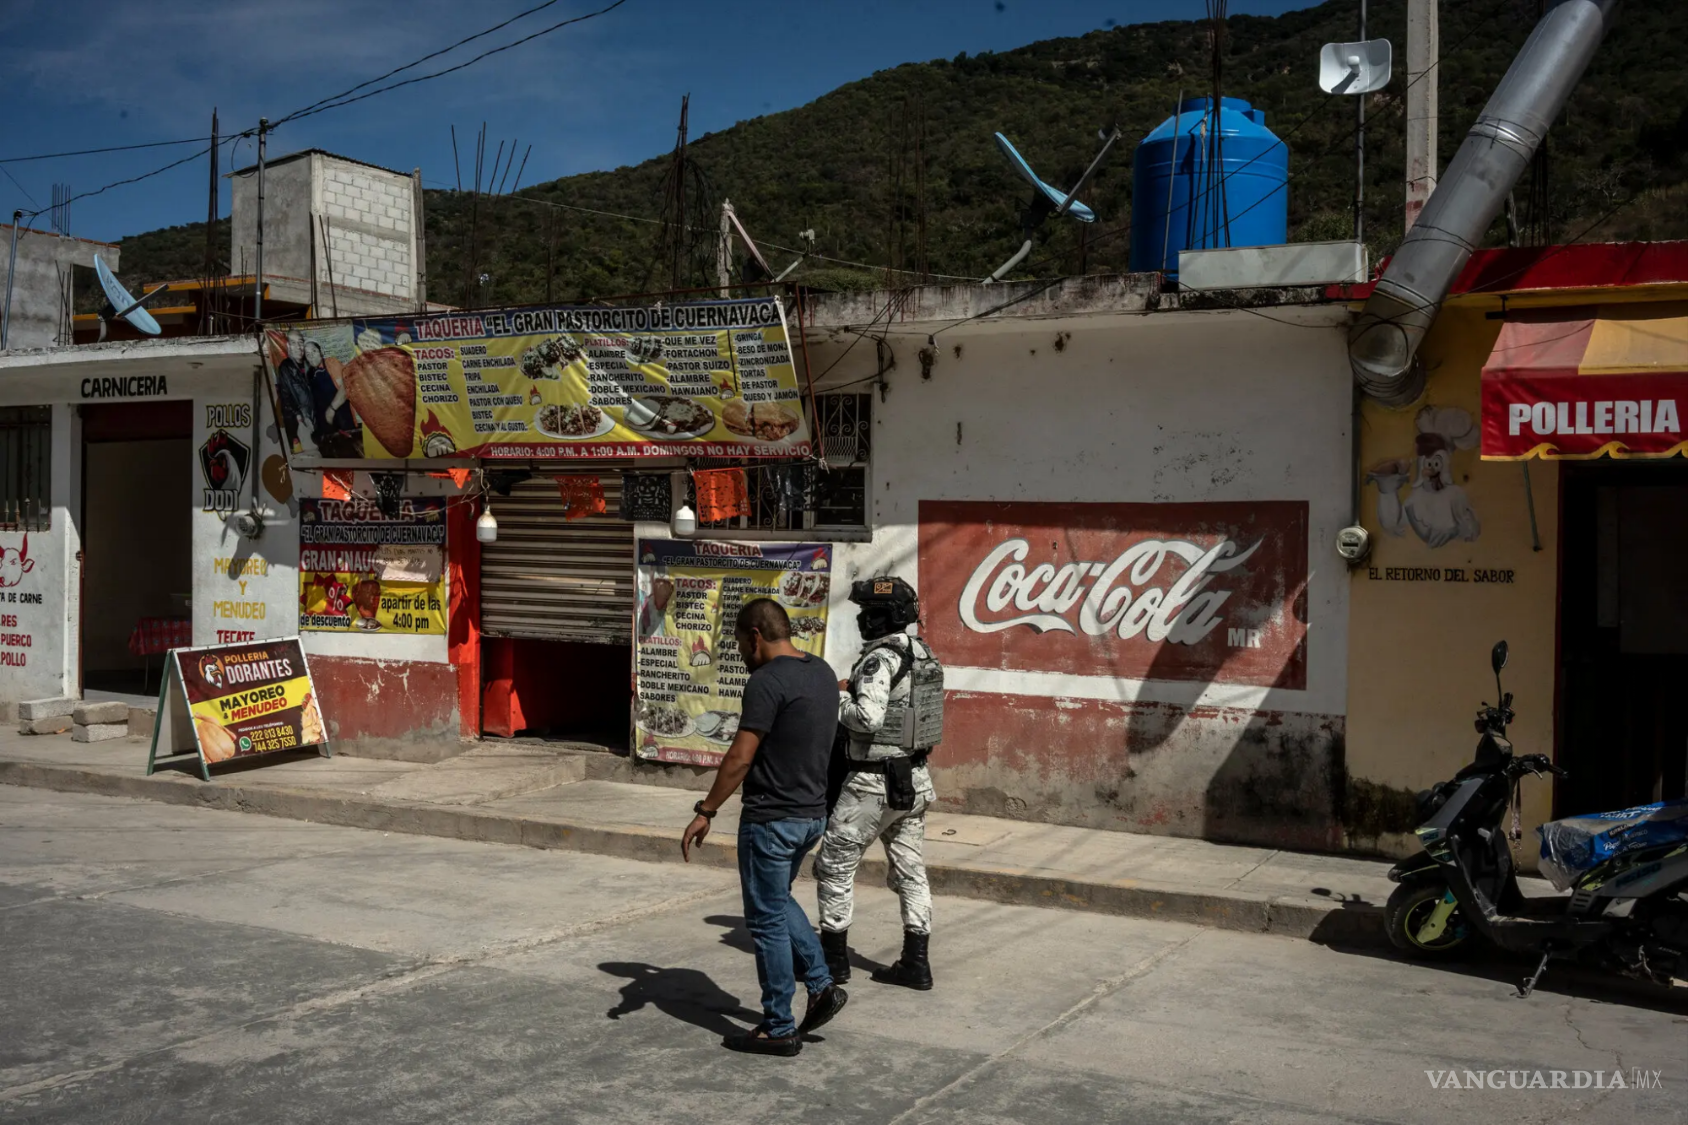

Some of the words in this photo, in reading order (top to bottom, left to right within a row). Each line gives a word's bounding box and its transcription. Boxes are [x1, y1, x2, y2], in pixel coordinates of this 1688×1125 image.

[415, 317, 486, 339] TAQUERIA
[514, 310, 553, 333] GRAN
[557, 308, 646, 331] PASTORCITO
[650, 308, 671, 328] DE
[675, 302, 781, 327] CUERNAVACA
[684, 336, 697, 345] ME
[699, 335, 716, 345] VEZ
[460, 346, 487, 356] SUADERO
[768, 344, 788, 352] MONJ
[414, 349, 455, 360] TACOS:
[417, 362, 448, 371] PASTOR
[462, 360, 481, 369] CARNE
[483, 357, 516, 368] ENCHILADA
[703, 360, 730, 370] SUIZO
[419, 372, 447, 382] BISTEC
[464, 372, 482, 381] TRIPA
[740, 369, 766, 378] TORTAS
[81, 375, 167, 398] CARNICERIA
[420, 384, 451, 392] CECINA
[467, 385, 500, 395] ENCHILADA
[622, 385, 666, 393] MEXICANO
[671, 385, 718, 395] HAWAIANO
[741, 381, 751, 389] DE
[752, 379, 778, 389] PASTOR
[422, 394, 459, 403] CHORIZO
[469, 397, 492, 407] PASTOR
[492, 397, 505, 406] CON
[506, 395, 523, 405] QUESO
[743, 393, 766, 401] QUESO
[767, 392, 773, 401] Y
[206, 404, 251, 428] POLLOS
[472, 410, 493, 420] BISTEC
[1508, 399, 1681, 436] POLLERIA
[474, 423, 496, 433] CECINA
[496, 423, 501, 432] Y
[501, 423, 508, 431] AL
[490, 446, 534, 457] HORARIO:
[536, 446, 556, 457] 4:00
[558, 446, 578, 457] P.M.
[580, 446, 588, 456] A
[590, 445, 613, 456] 1:00
[616, 445, 640, 456] A.M.
[642, 445, 703, 456] DOMINGOS
[707, 445, 724, 456] NO
[726, 445, 750, 456] HAY
[754, 445, 810, 456] SERVICIO
[203, 488, 240, 512] DODI
[320, 499, 415, 522] TAQUEA
[314, 526, 335, 543] GRAN
[335, 526, 379, 542] PASTORCITO
[380, 526, 391, 542] DE
[694, 542, 762, 557] TAQUERIA
[214, 558, 267, 575] MAYOREO
[302, 550, 336, 571] GRAN
[341, 550, 378, 571] INAU
[676, 557, 695, 566] GRAN
[696, 557, 738, 568] PASTORCITO
[739, 558, 749, 568] DE
[723, 577, 752, 585] SUADERO
[1369, 567, 1382, 580] EL
[1385, 567, 1441, 581] RETORNO
[1444, 568, 1469, 582] DEL
[1473, 569, 1515, 583] SABOR
[238, 580, 248, 595] Y
[676, 578, 717, 590] TACOS:
[723, 585, 743, 593] CARNE
[745, 587, 780, 595] ENCHILADA
[958, 535, 1266, 645] Coca-Cola
[8, 592, 17, 603] DE
[19, 593, 43, 604] CARNE
[676, 591, 708, 600] PASTOR
[381, 595, 411, 613] apartir
[414, 595, 425, 611] de
[428, 594, 441, 611] las
[676, 601, 705, 610] BISTEC
[213, 601, 266, 620] MENUDEO
[676, 611, 706, 621] CECINA
[1, 614, 17, 627] RES
[301, 614, 310, 626] de
[312, 614, 350, 627] descuento
[392, 613, 412, 629] 4:00
[415, 619, 429, 632] pm
[675, 622, 712, 632] CHORIZO
[0, 633, 32, 647] PUERCO
[638, 635, 682, 646] PLATILLOS:
[1227, 627, 1261, 649] MR
[1, 651, 26, 667] POLLO
[224, 651, 269, 664] POLLERIA
[225, 658, 293, 684] DORANTES
[717, 676, 747, 687] -ALAMB
[667, 682, 709, 694] MEXICANO
[718, 688, 743, 698] HAWA
[219, 685, 285, 711] MAYOREO
[231, 697, 287, 721] MENUDEO
[250, 730, 264, 742] 222
[276, 725, 294, 737] 8430
[253, 742, 267, 752] 744
[266, 738, 280, 750] 325
[279, 735, 297, 748] 7550
